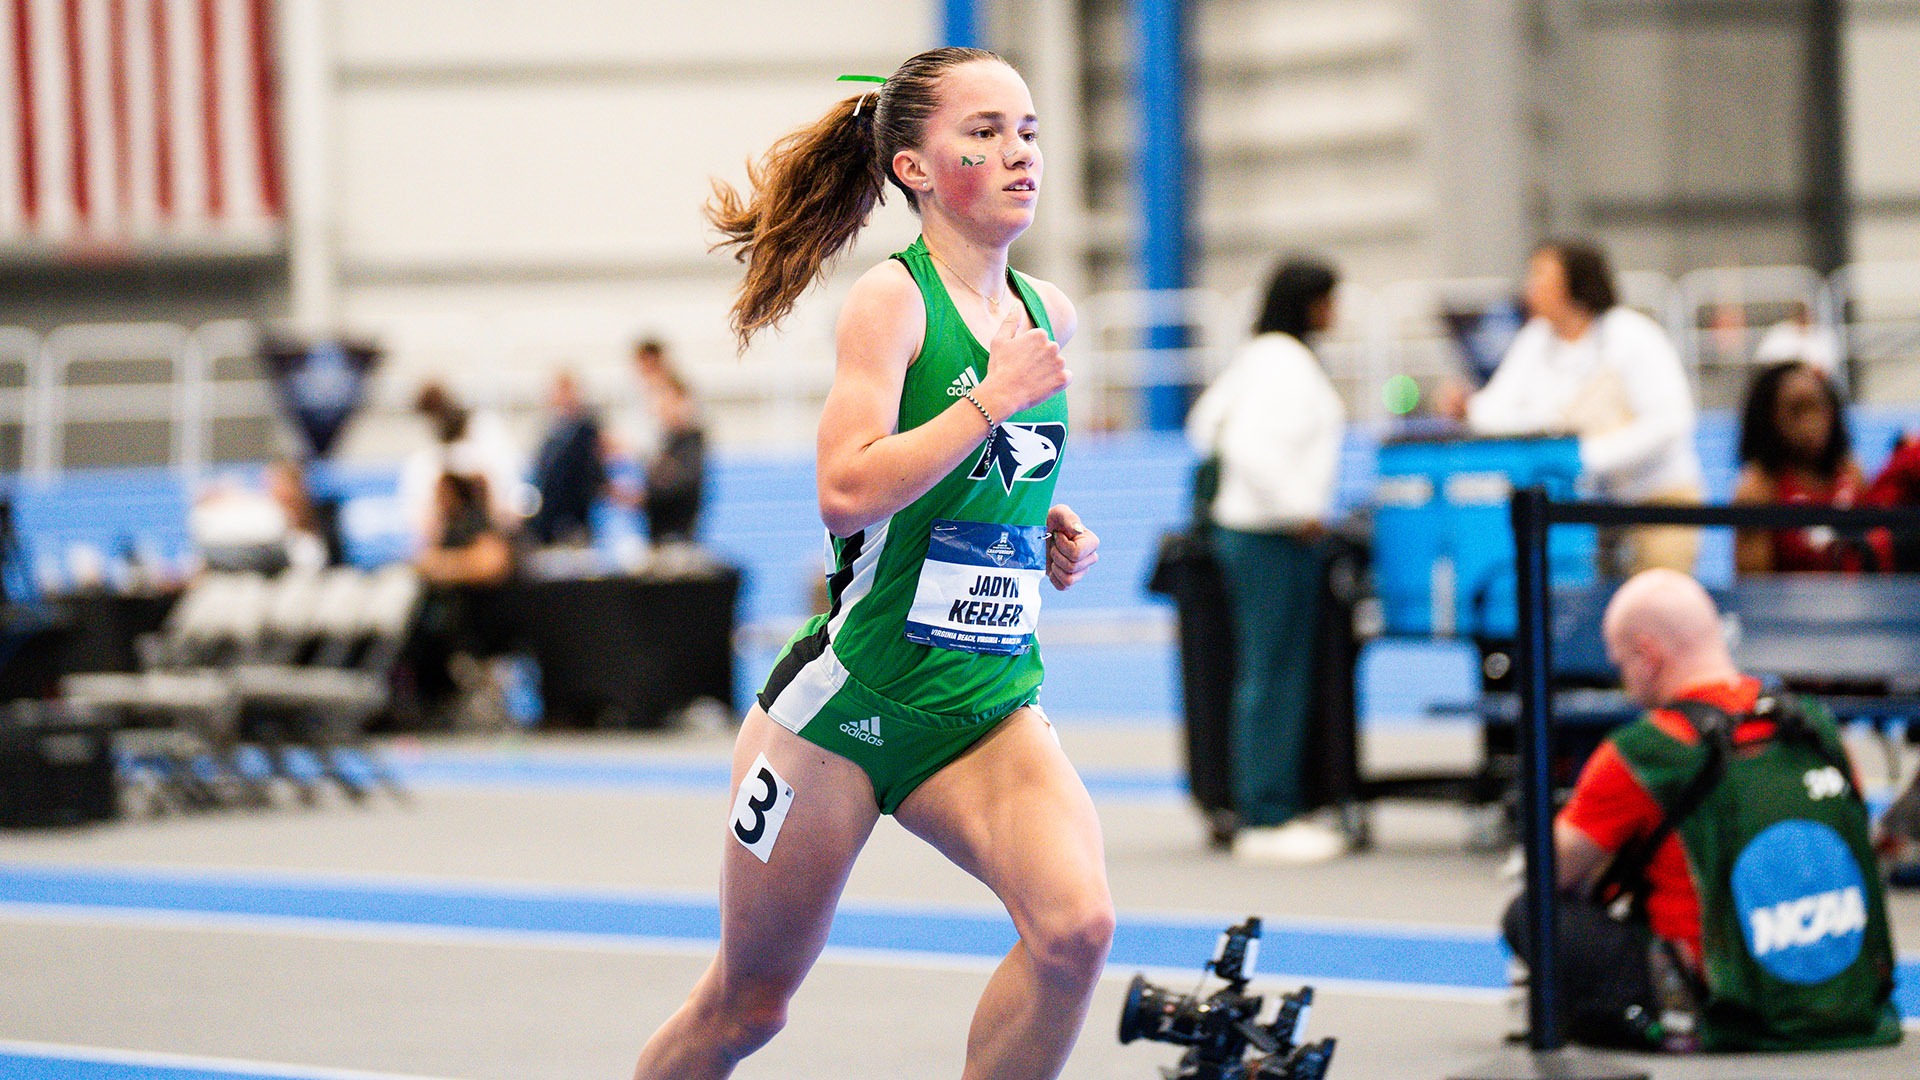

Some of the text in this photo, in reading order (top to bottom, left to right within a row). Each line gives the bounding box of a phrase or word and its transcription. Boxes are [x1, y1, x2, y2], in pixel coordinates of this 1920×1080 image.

[969, 575, 1019, 598] JADYN
[948, 599, 1023, 627] KEELER
[931, 629, 957, 640] VIRGINIA
[957, 634, 976, 642] BEACH,
[839, 721, 885, 747] adidas
[734, 767, 778, 845] 3
[1749, 884, 1867, 957] NCAA
